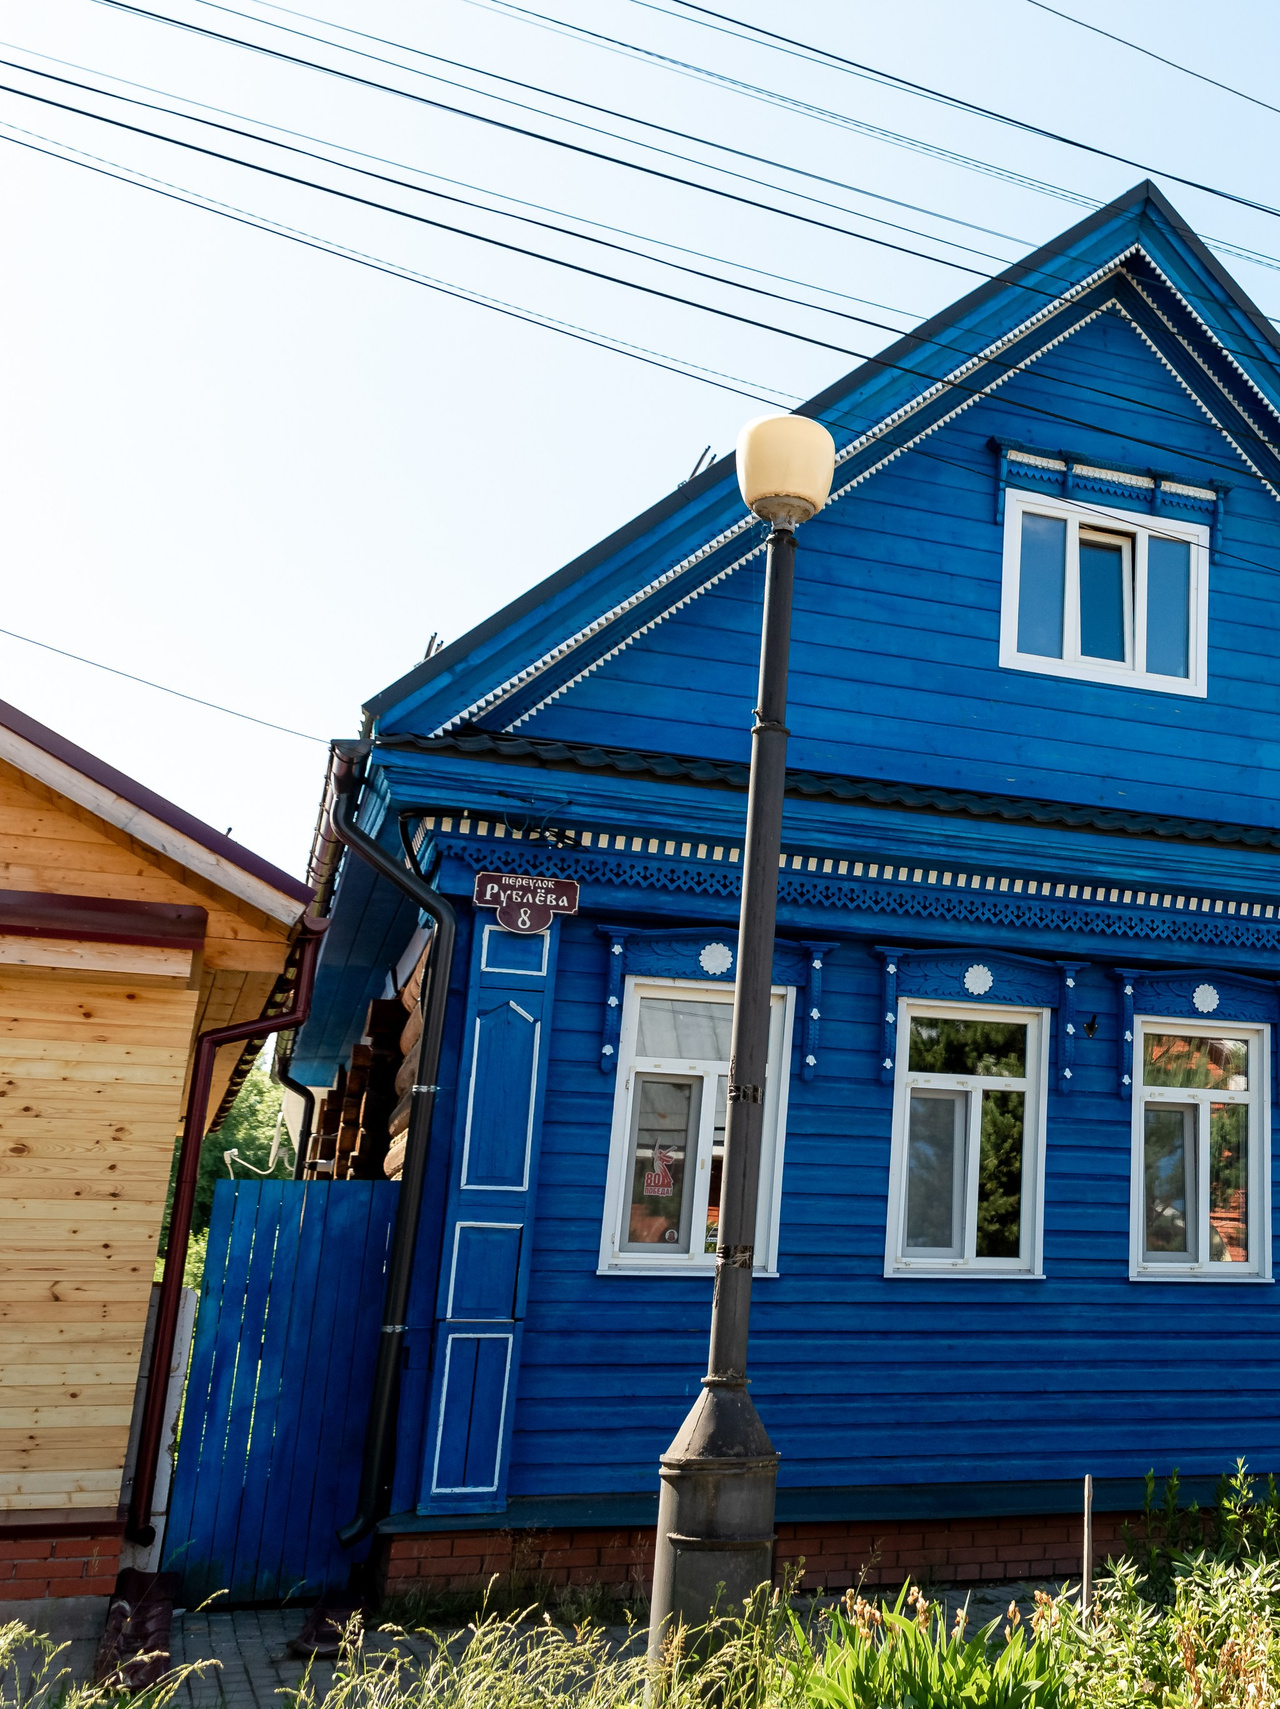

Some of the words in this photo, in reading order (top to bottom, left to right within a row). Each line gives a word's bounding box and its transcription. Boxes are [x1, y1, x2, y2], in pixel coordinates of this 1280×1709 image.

[483, 883, 569, 907] Рублёва
[517, 907, 531, 928] 8
[645, 1172, 662, 1186] 80
